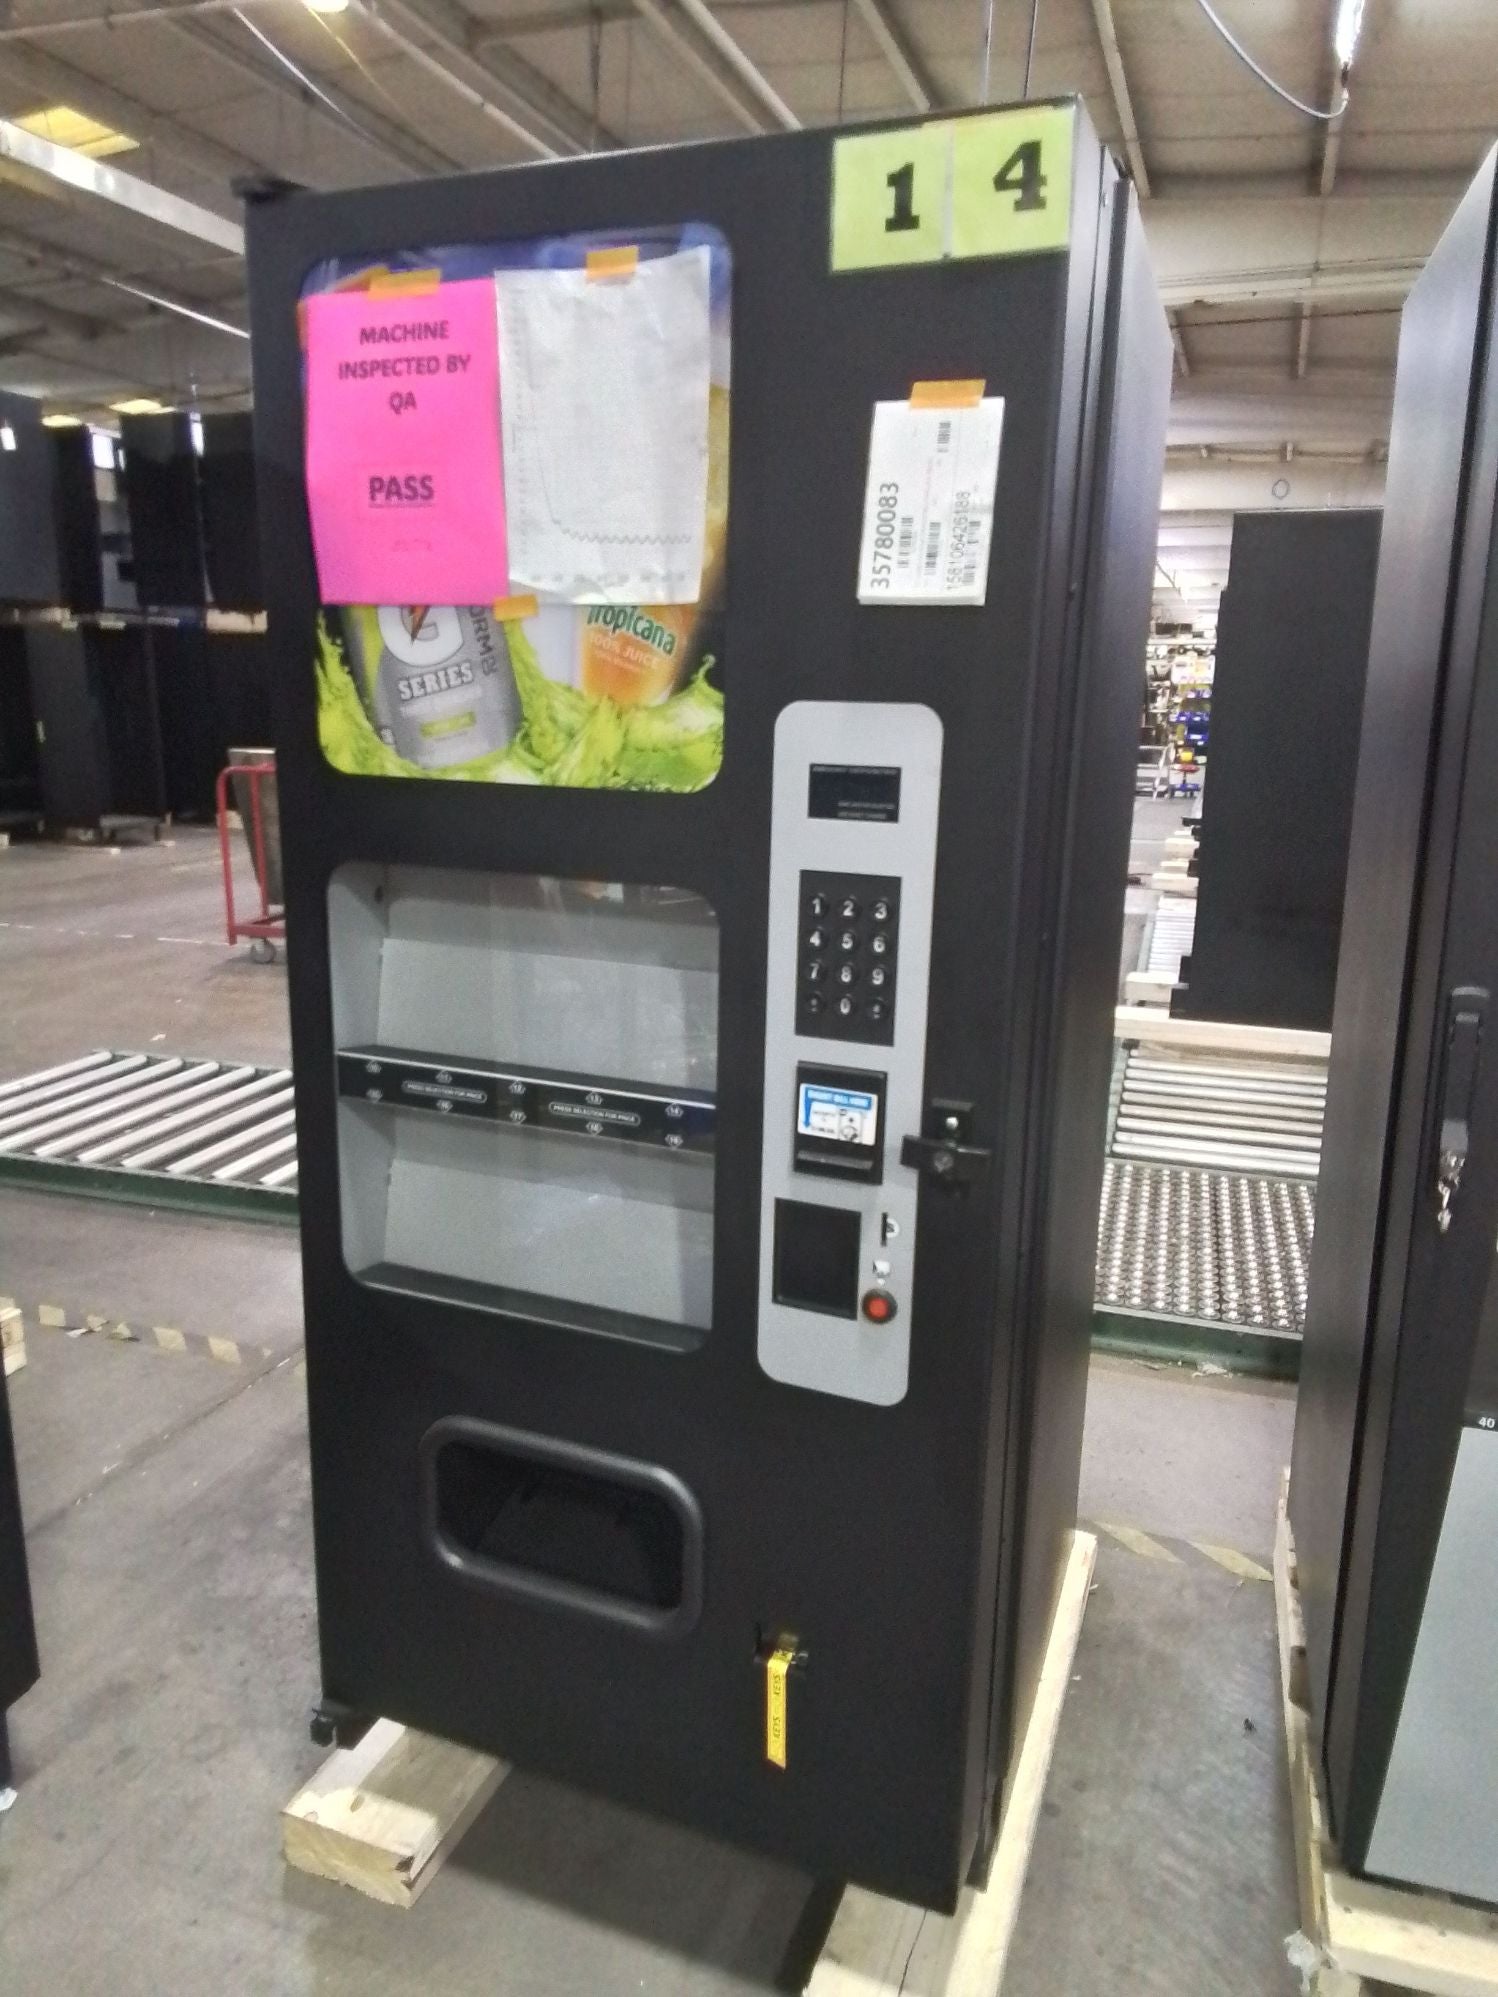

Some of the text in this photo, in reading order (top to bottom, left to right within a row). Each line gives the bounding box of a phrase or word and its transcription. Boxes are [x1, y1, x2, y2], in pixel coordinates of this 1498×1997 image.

[885, 138, 1048, 232] 1 4
[359, 320, 449, 345] MACHINE
[338, 353, 471, 380] INSPECTED BY
[389, 390, 417, 415] QA
[368, 474, 434, 502] PASS
[870, 482, 899, 589] 35780083
[398, 662, 474, 700] SERIES
[812, 898, 888, 919] 1 2 3
[810, 931, 886, 953] 4 5 6
[810, 963, 884, 985] 7 8 9
[840, 998, 850, 1014] 0
[1478, 1416, 1496, 1429] 40
